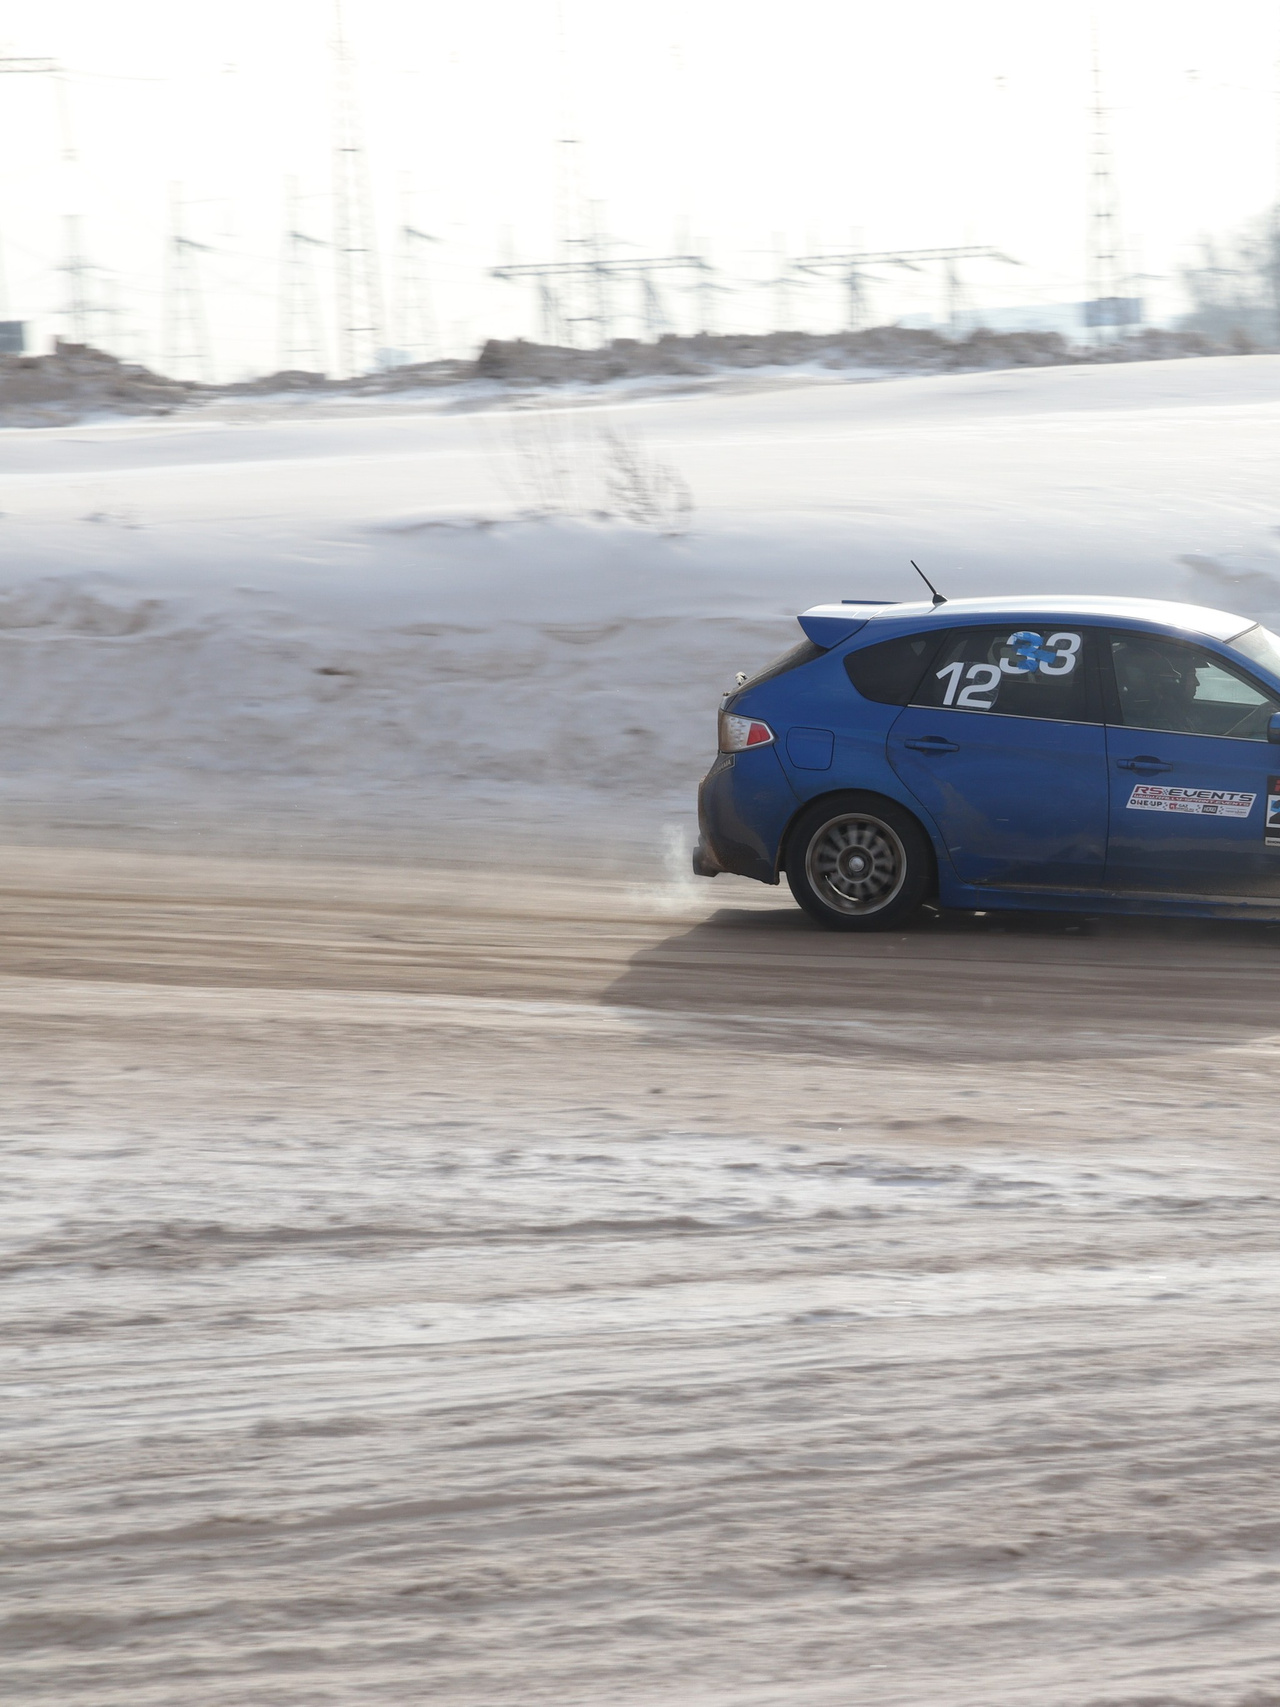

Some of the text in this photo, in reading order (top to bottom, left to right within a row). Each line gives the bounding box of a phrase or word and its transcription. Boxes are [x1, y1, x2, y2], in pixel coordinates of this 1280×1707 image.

[935, 661, 1002, 709] 12
[1134, 785, 1254, 802] RS EVENTS
